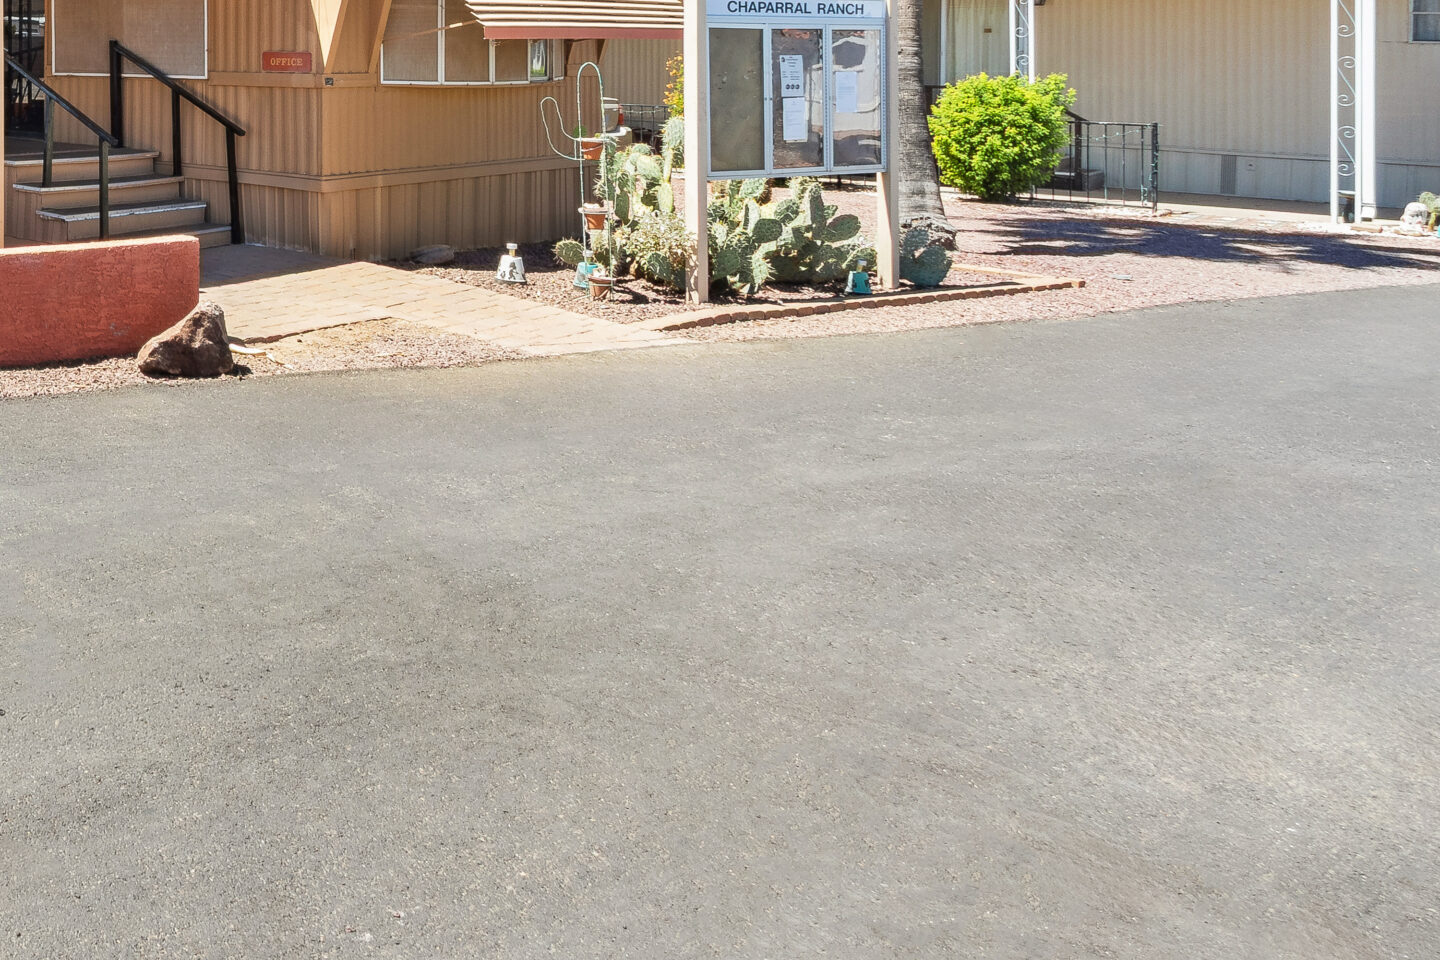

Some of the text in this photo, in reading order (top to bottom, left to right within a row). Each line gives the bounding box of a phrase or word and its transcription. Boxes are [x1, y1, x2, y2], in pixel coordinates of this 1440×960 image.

[727, 0, 864, 15] CHAPARRAL RANCH
[270, 57, 303, 66] OFFICE
